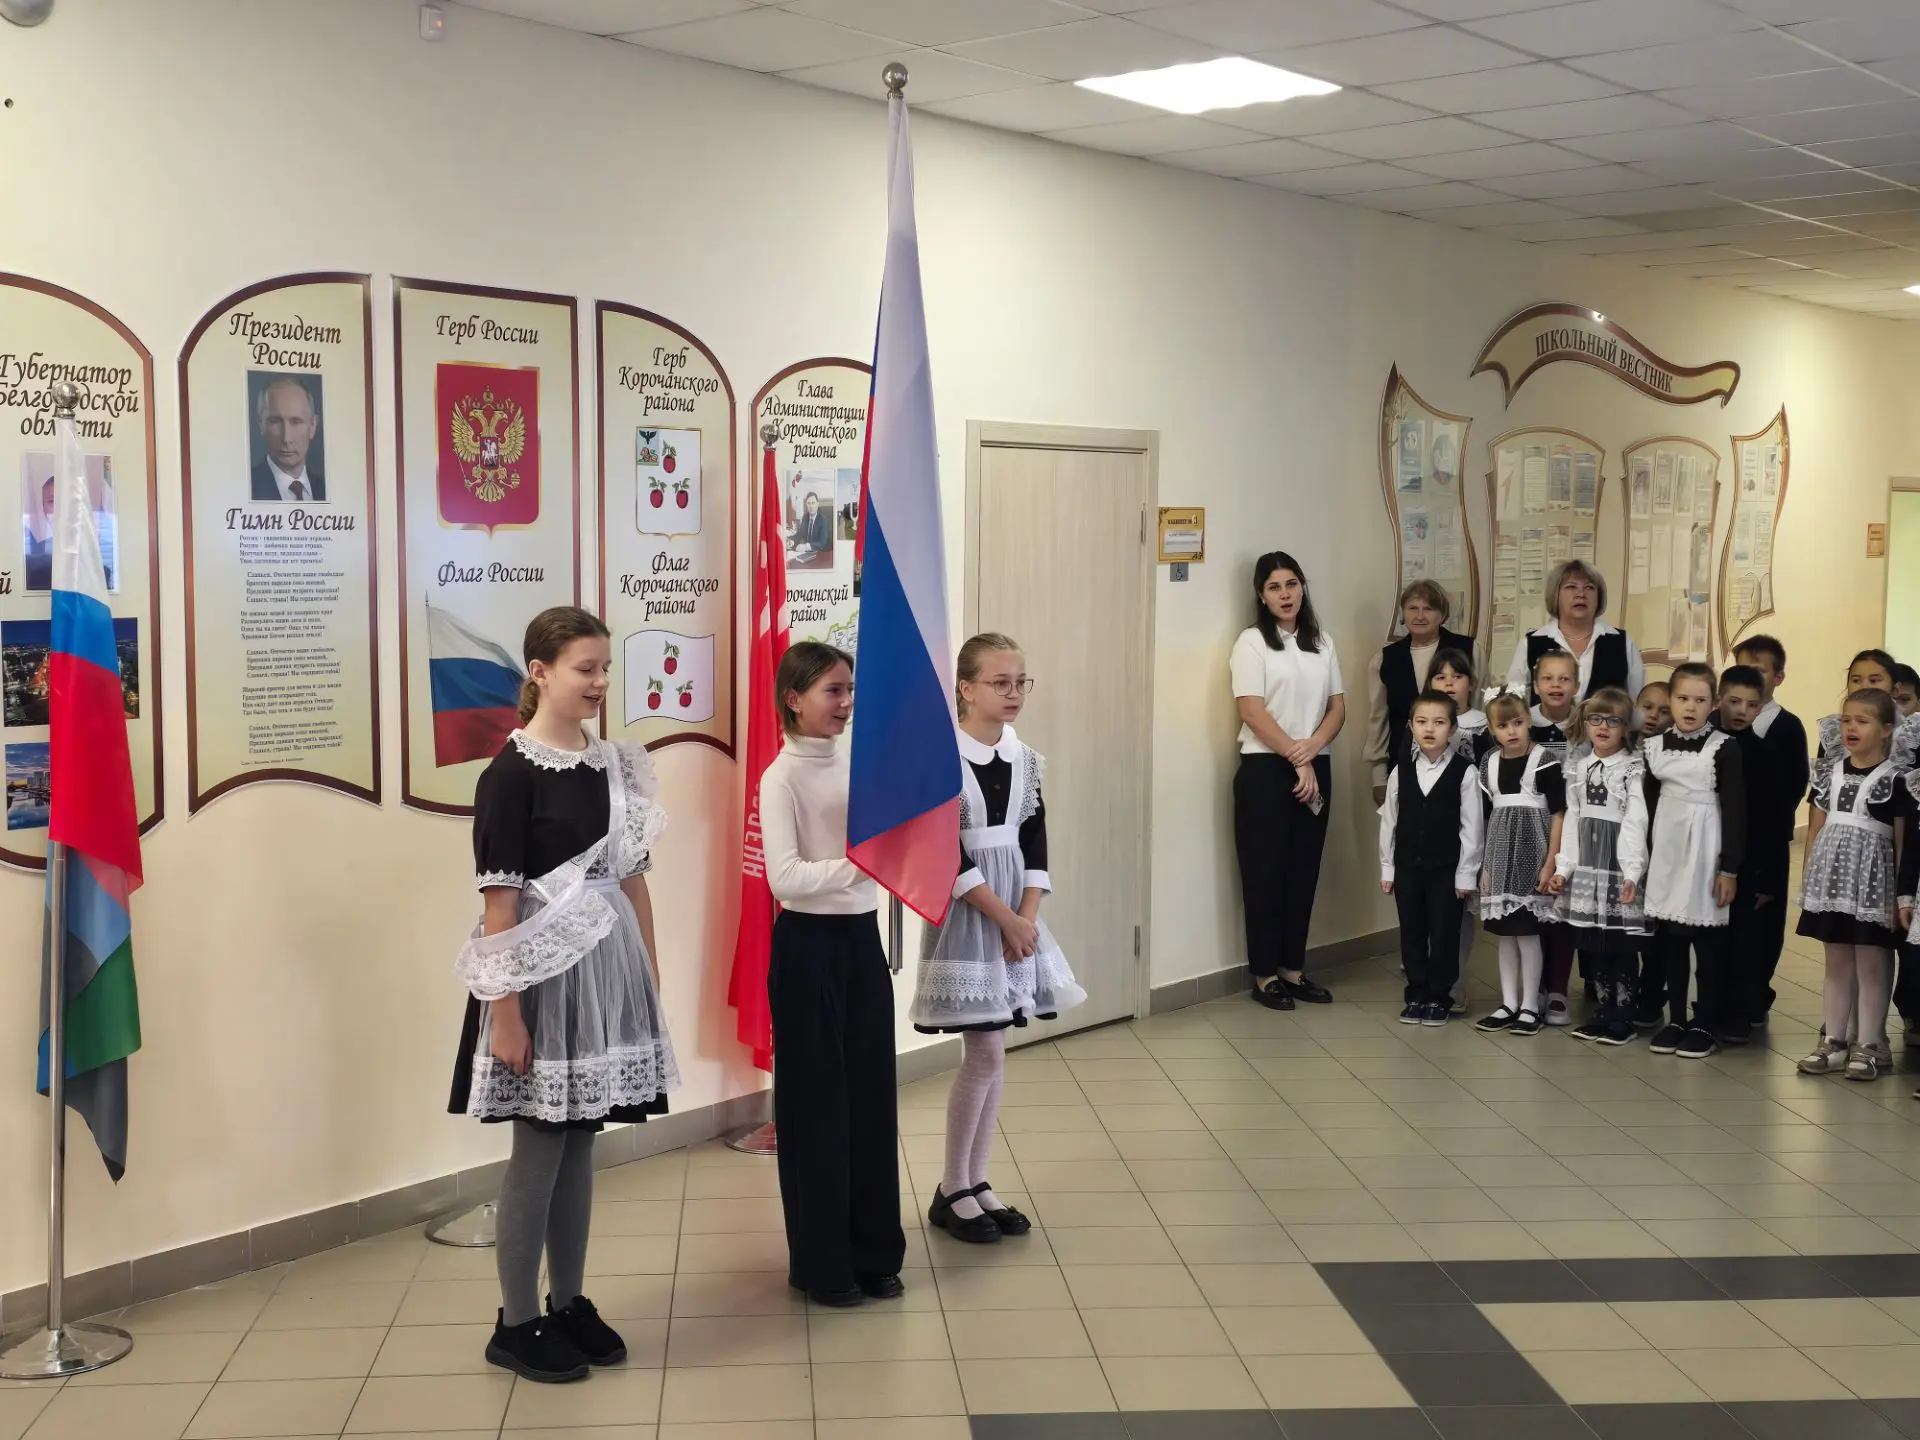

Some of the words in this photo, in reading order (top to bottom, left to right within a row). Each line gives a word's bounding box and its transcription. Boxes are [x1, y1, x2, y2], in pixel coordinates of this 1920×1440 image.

[229, 312, 341, 345] Президент
[436, 315, 480, 345] Герб
[481, 319, 539, 344] России
[253, 342, 321, 369] России
[653, 346, 689, 374] Герб
[1536, 328, 1616, 364] ШКОЛЬНЫЙ
[1620, 348, 1673, 393] ВЕСТНИК
[0, 352, 132, 394] Губернатор
[618, 366, 719, 396] Корочанского
[0, 382, 139, 418] елгодской
[798, 379, 834, 399] Глава
[643, 392, 695, 416] района
[761, 395, 865, 425] Администрации
[20, 408, 113, 438] облти
[793, 441, 837, 463] района
[226, 508, 283, 530] Гимн
[288, 508, 355, 531] России
[438, 560, 483, 586] Флаг
[487, 562, 544, 582] России
[652, 551, 690, 575] Флаг
[620, 574, 719, 600] Корочанского
[786, 584, 849, 606] рочанский
[644, 596, 696, 621] района
[788, 605, 826, 628] район
